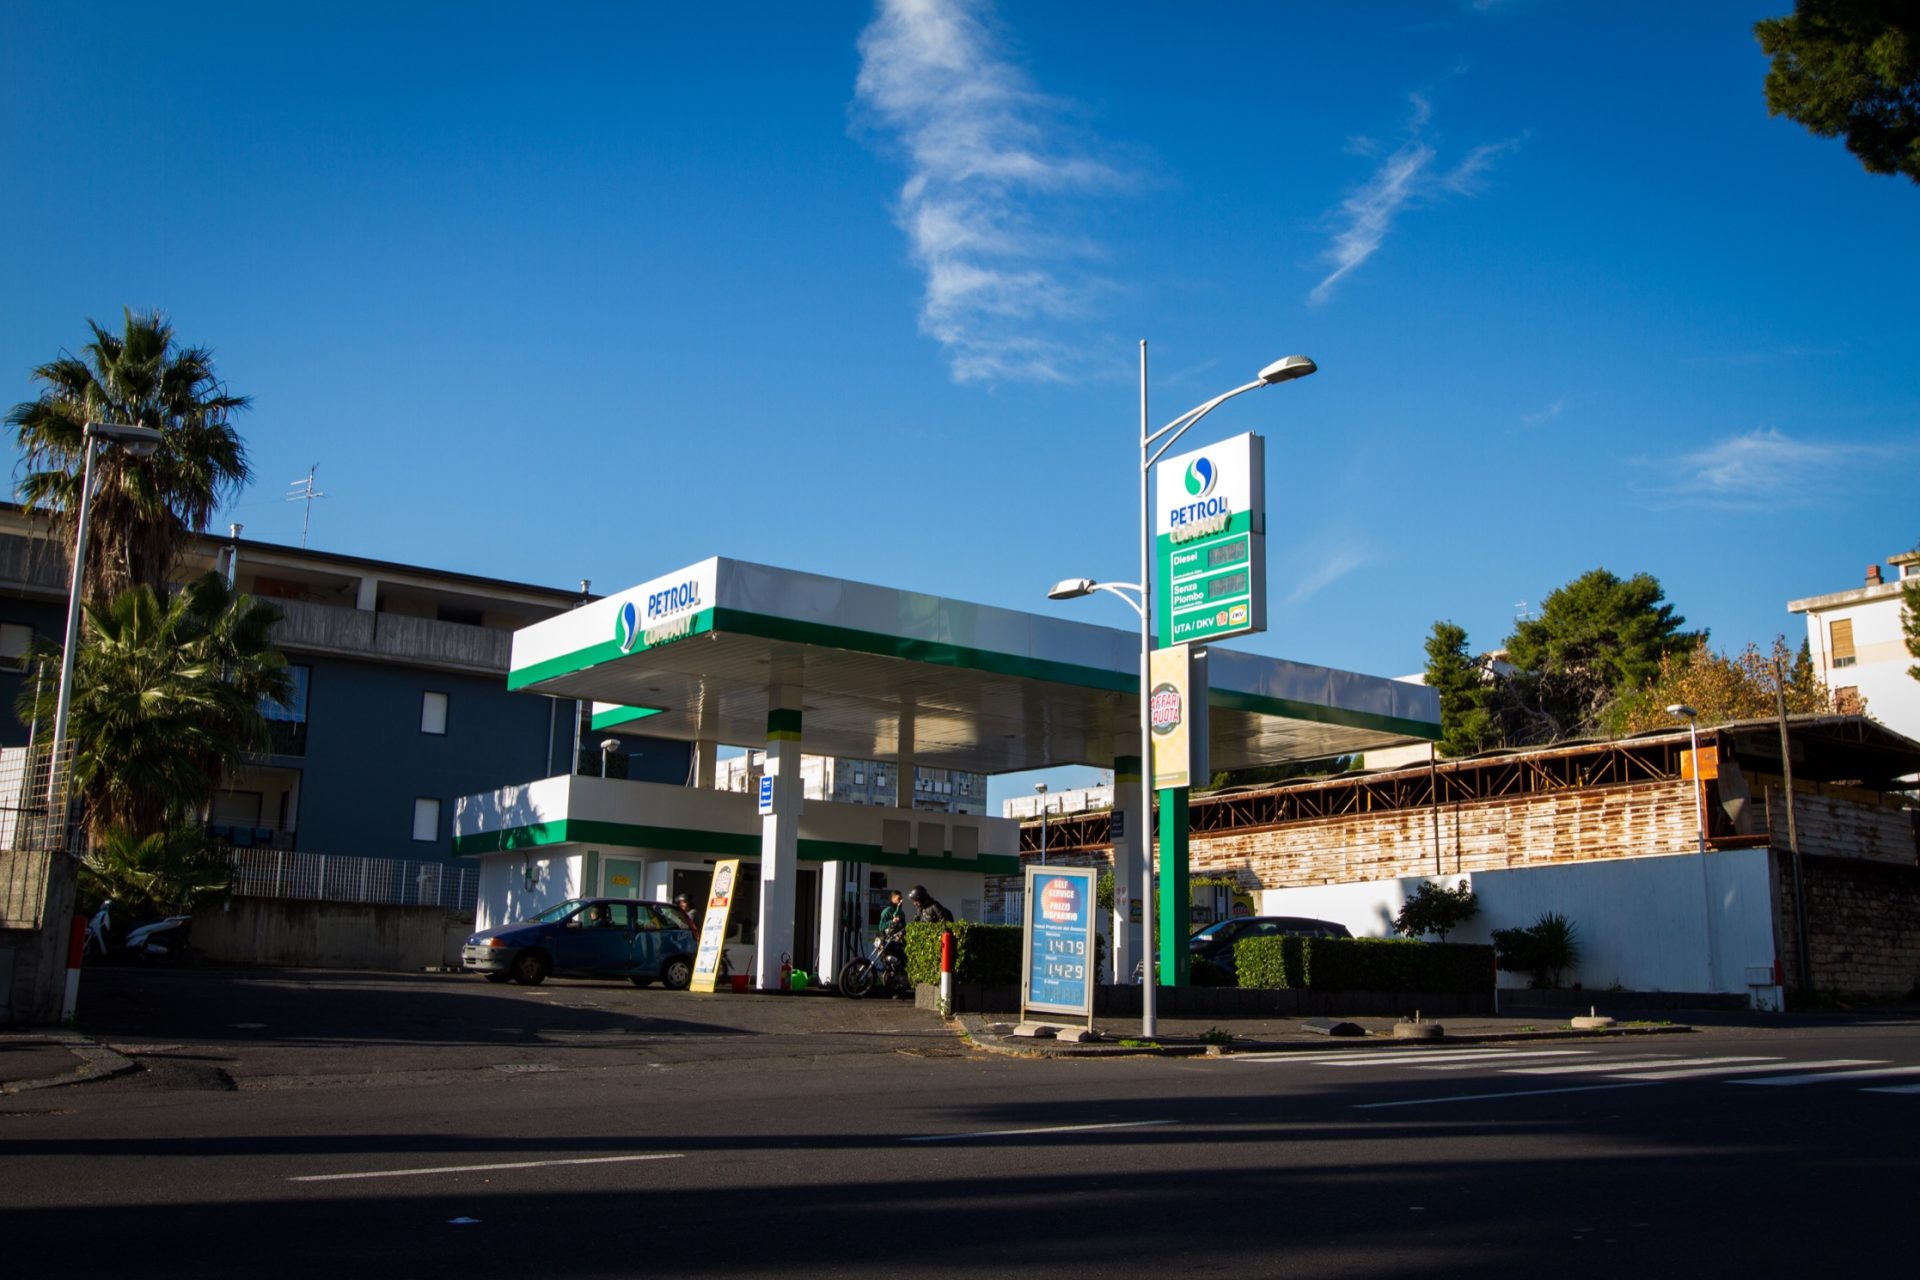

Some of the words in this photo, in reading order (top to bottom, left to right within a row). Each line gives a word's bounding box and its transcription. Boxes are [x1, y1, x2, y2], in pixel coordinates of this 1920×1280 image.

[1170, 496, 1226, 527] PETROL
[1174, 551, 1198, 566] Diesel
[1174, 583, 1198, 595] Senza
[648, 580, 695, 617] PETROL
[1174, 623, 1191, 634] UTA
[1196, 617, 1214, 629] DKV
[1150, 693, 1180, 710] AFFARI
[1152, 707, 1179, 725] RUOTA
[1053, 880, 1068, 889] SELF
[1048, 889, 1075, 899] SERVICE
